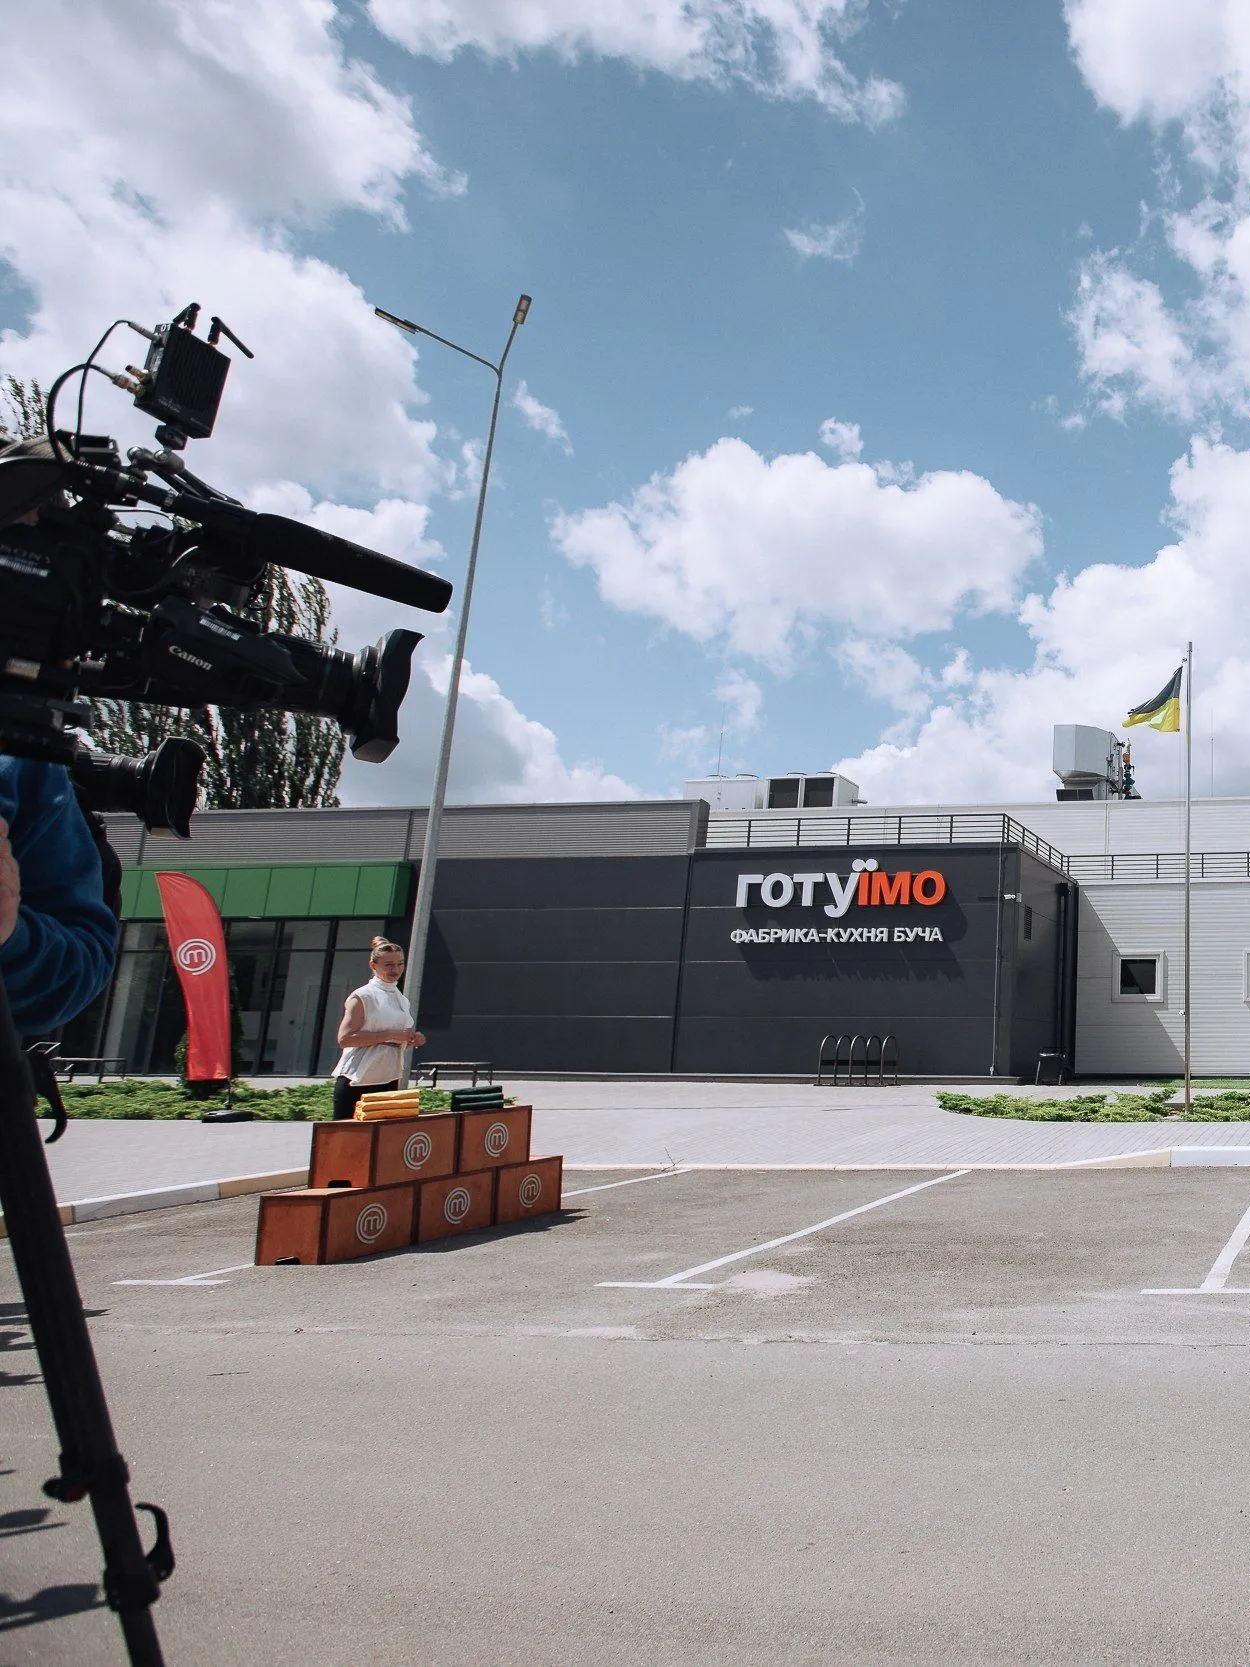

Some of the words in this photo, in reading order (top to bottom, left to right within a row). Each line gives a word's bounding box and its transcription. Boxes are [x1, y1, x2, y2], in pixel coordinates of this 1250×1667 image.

[167, 645, 214, 671] Canon
[730, 928, 888, 943] ФАБРИКА-КУХНЯ
[893, 927, 943, 942] БУЧА
